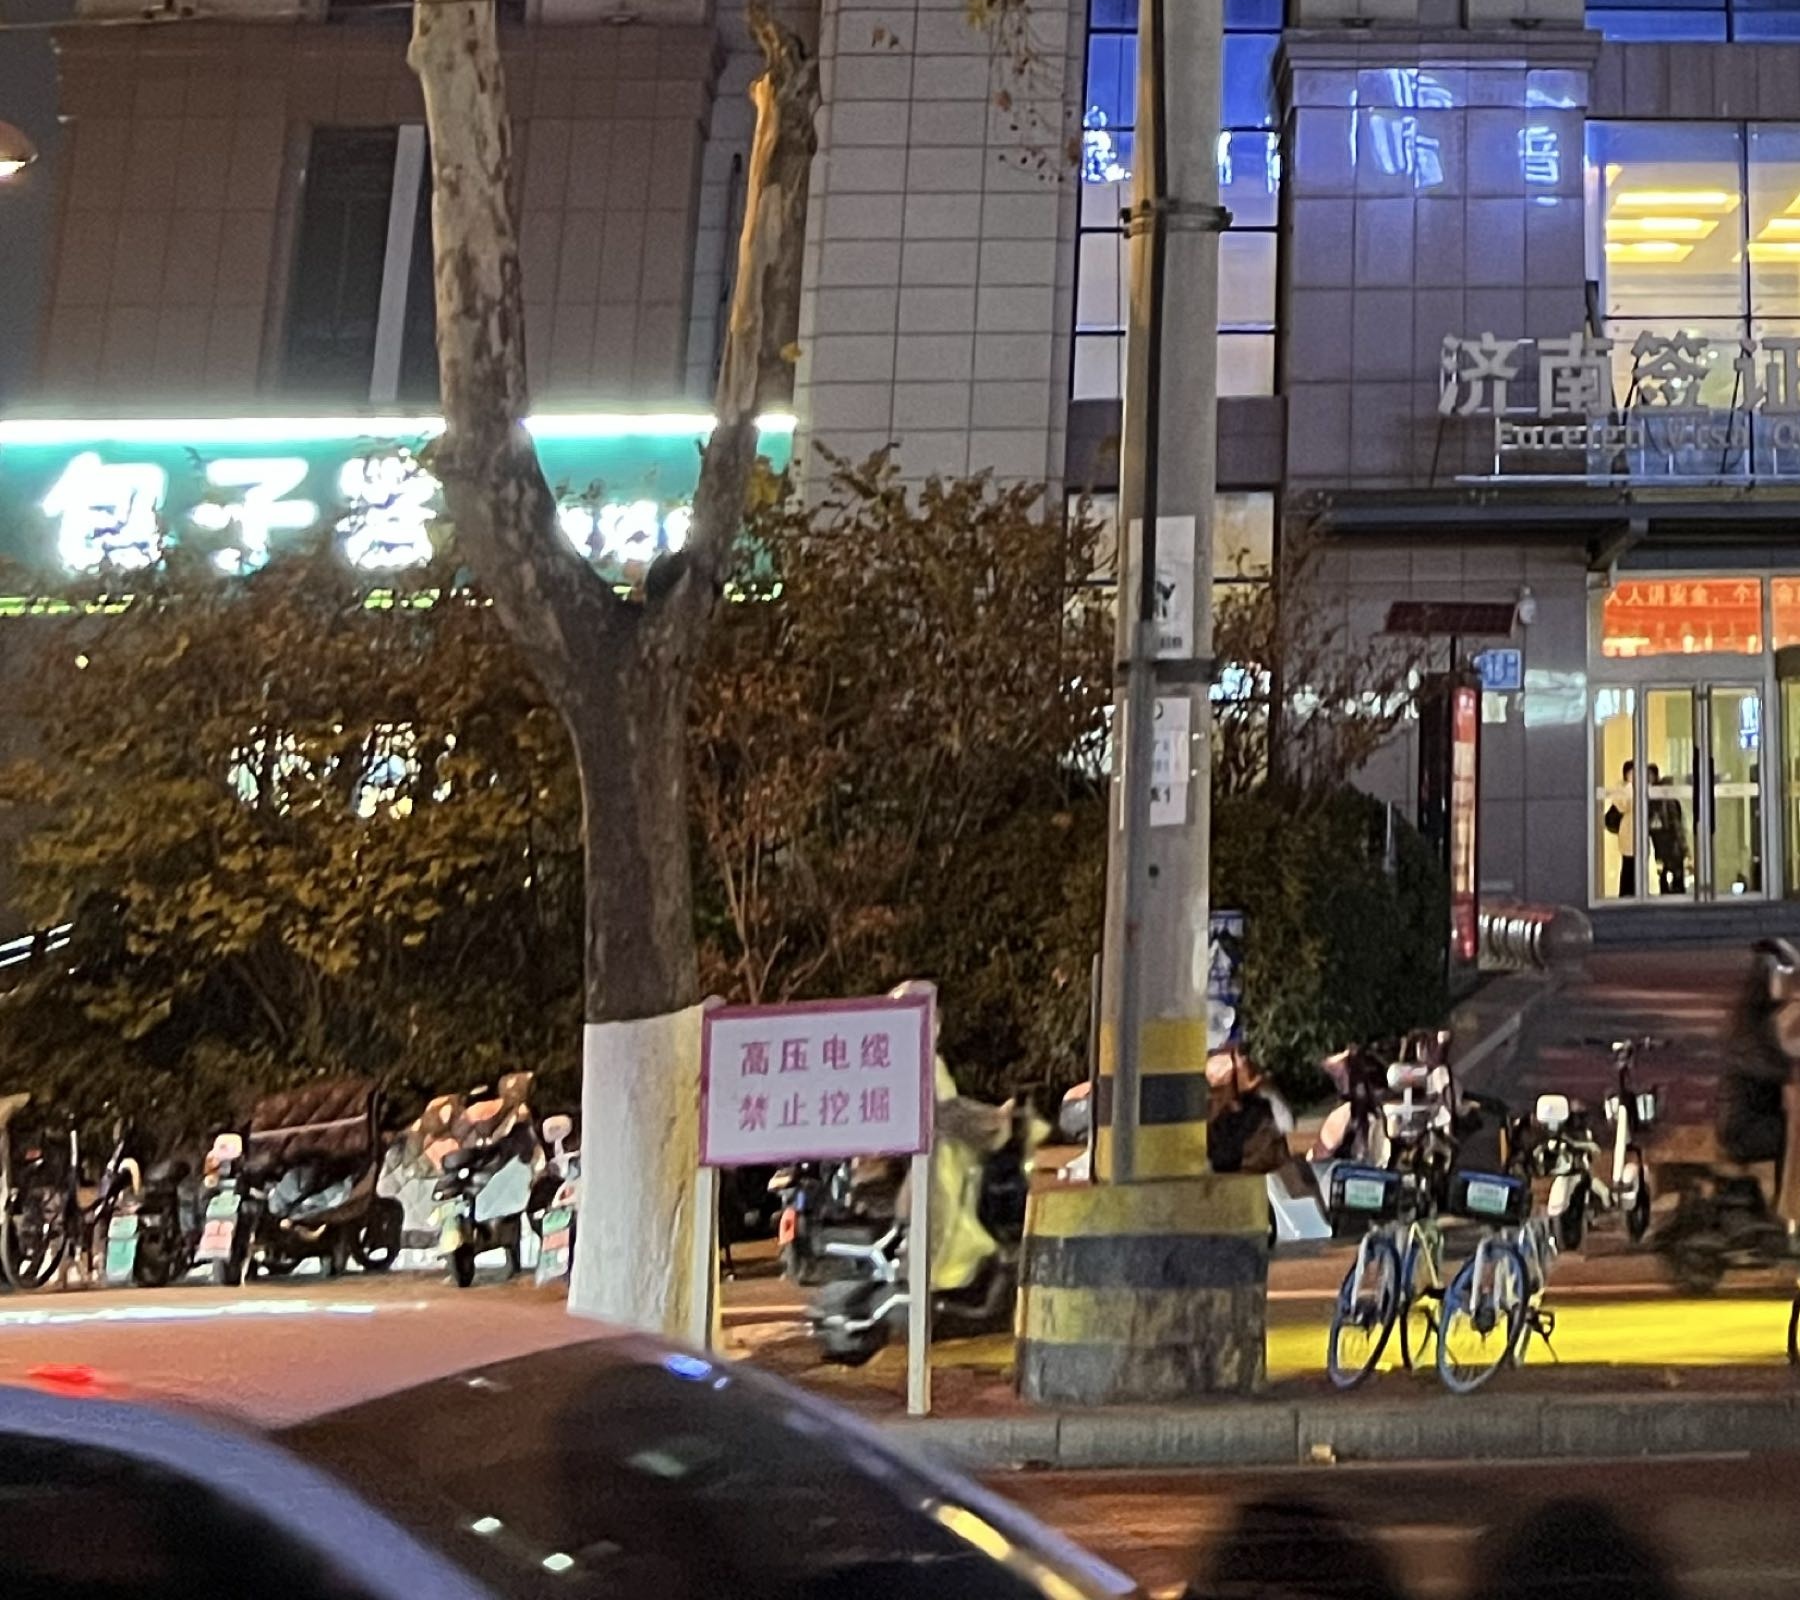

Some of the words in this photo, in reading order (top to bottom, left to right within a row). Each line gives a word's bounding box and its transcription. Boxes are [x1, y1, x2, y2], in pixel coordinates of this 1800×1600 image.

[740, 1032, 891, 1077] 高压电缆
[738, 1086, 891, 1133] 禁止挖掘
